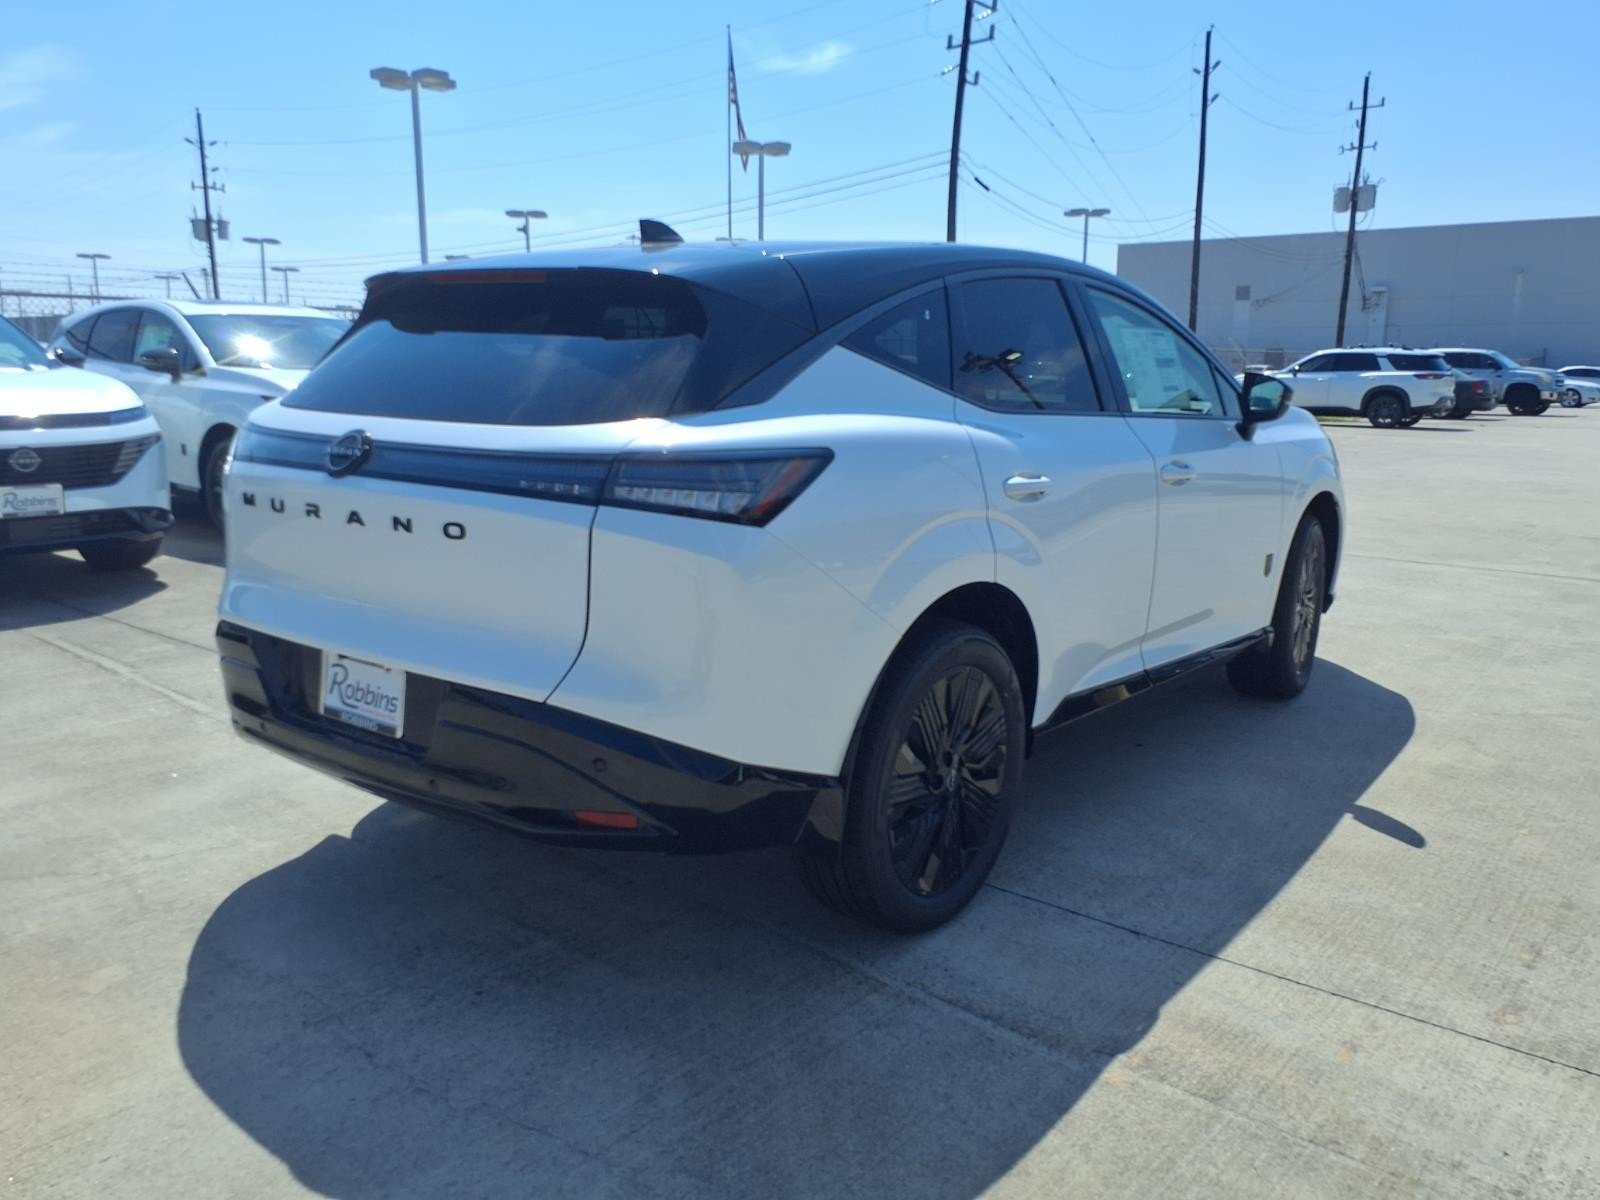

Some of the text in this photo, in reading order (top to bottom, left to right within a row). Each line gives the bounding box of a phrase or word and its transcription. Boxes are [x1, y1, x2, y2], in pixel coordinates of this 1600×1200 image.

[3, 492, 57, 511] Robbins
[242, 492, 467, 540] MURANO
[328, 663, 399, 713] Robbins
